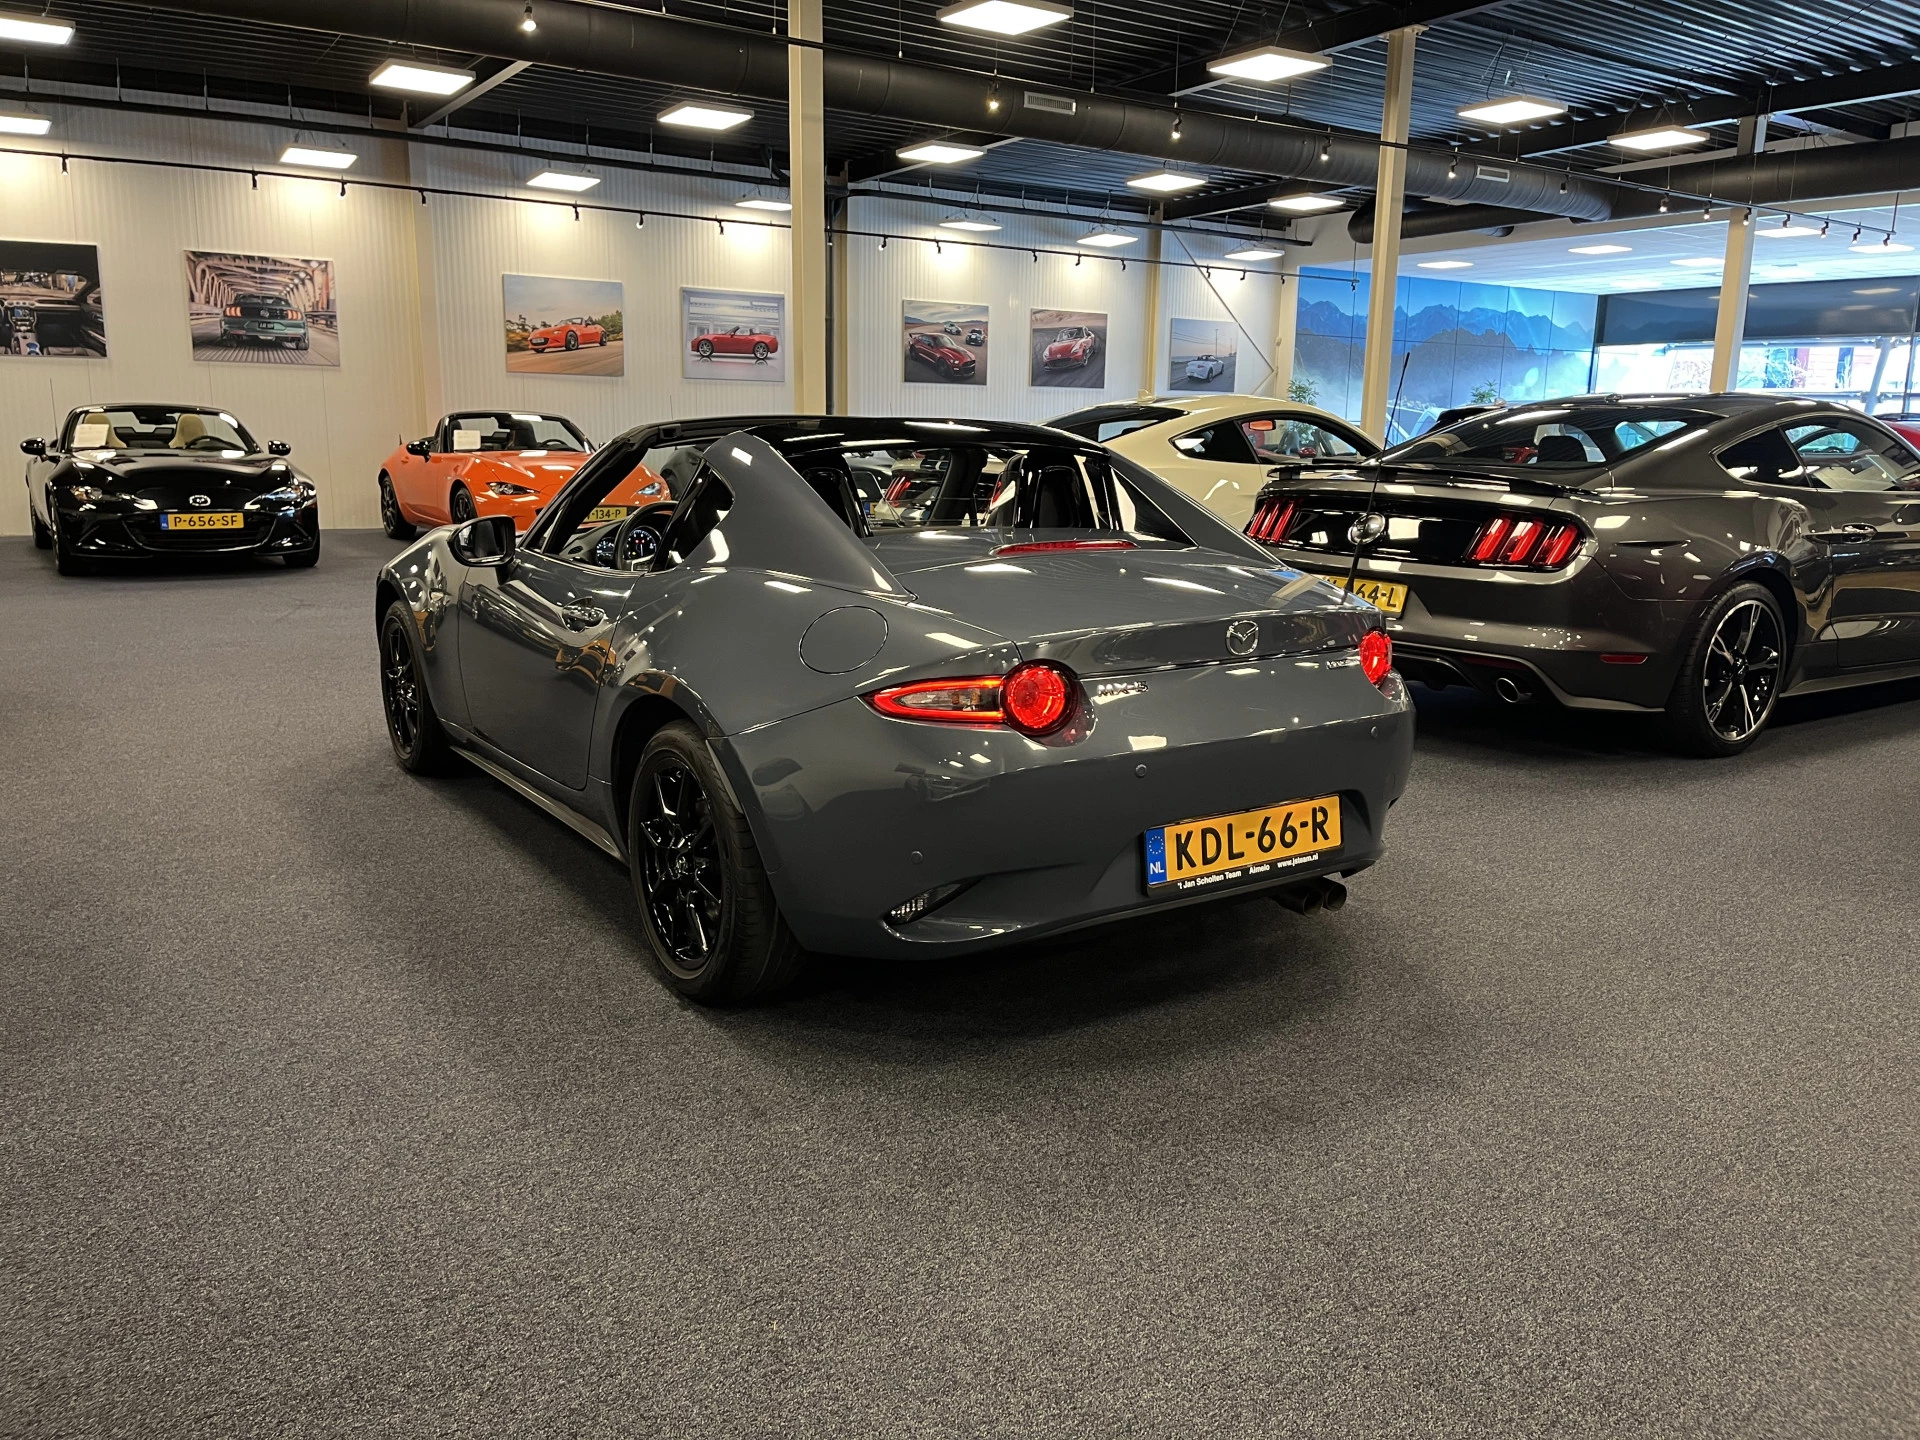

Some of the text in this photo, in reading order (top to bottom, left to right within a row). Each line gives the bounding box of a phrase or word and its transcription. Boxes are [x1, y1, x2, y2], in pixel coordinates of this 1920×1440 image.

[173, 514, 238, 528] P-656-SF
[1097, 680, 1149, 697] MX-5
[1175, 805, 1330, 871] KDL-66-R
[1149, 861, 1165, 875] NL
[1183, 880, 1196, 889] Jan
[1196, 874, 1224, 886] Scholten
[1224, 870, 1242, 880] Team
[1248, 863, 1270, 874] Almelo
[1277, 852, 1319, 866] www.jsteam.nl
